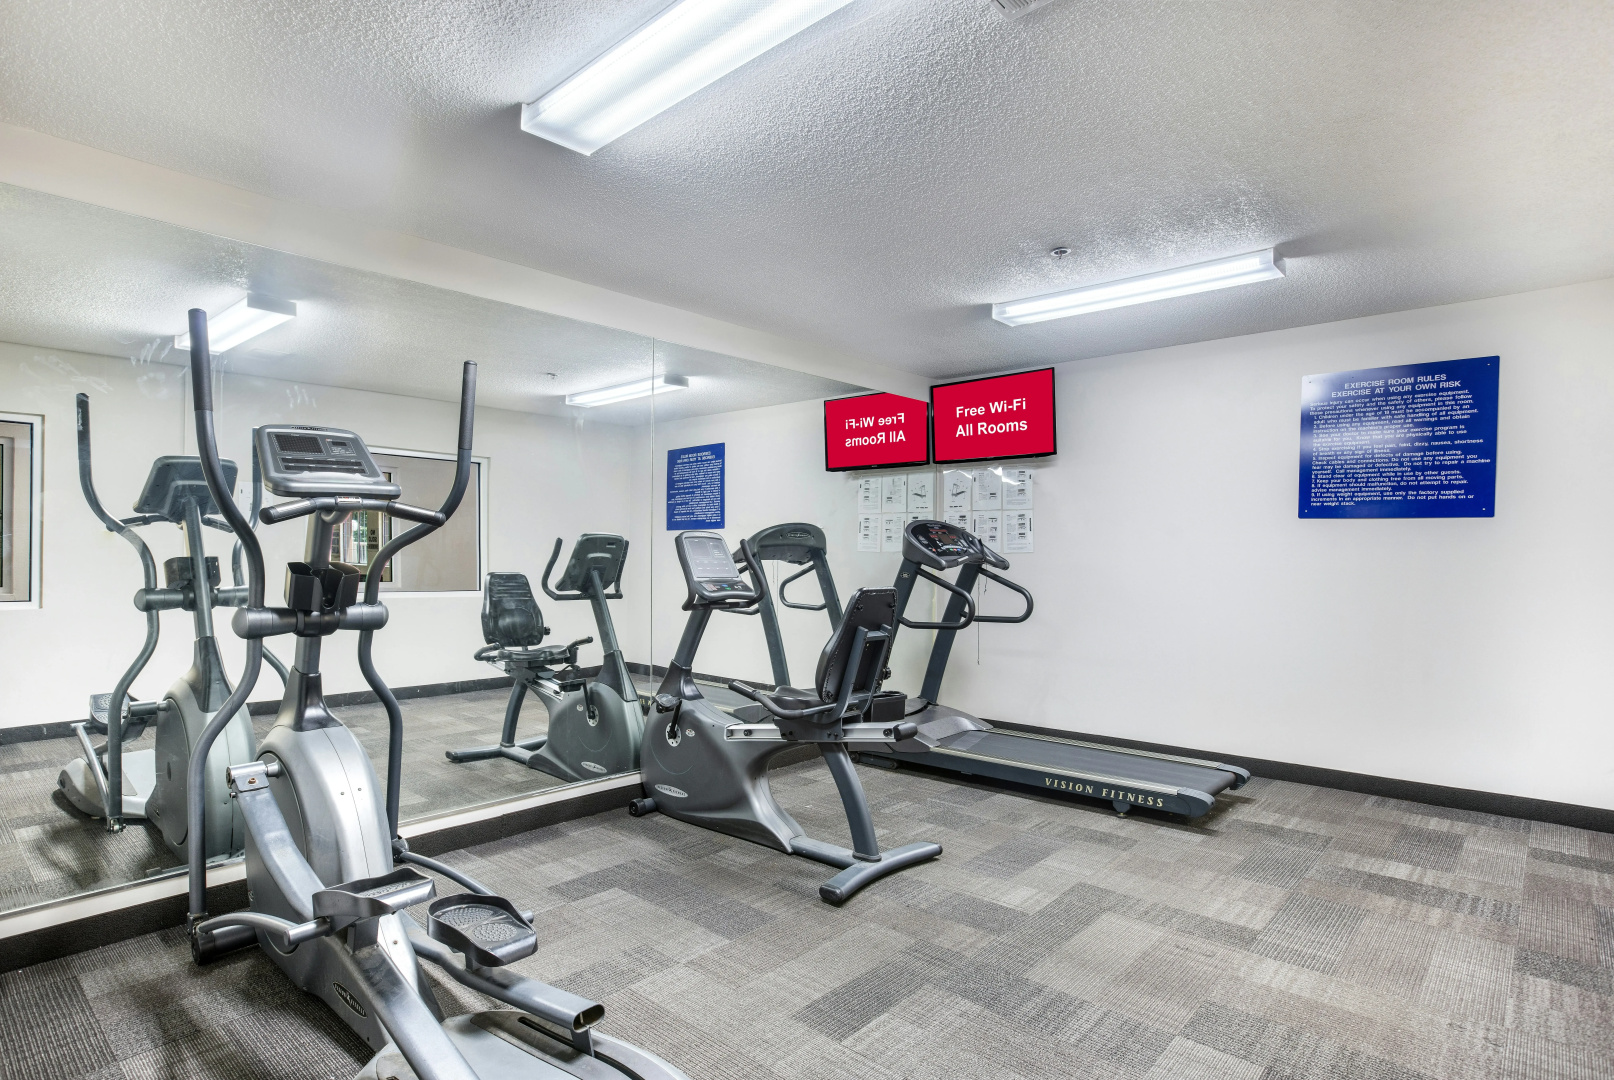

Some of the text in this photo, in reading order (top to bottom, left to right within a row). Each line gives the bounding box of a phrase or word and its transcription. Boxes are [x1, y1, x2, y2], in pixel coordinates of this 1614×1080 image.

[1332, 388, 1371, 398] EXERCISE
[1389, 385, 1412, 393] YOUR
[1415, 383, 1436, 391] OWN
[1440, 380, 1461, 389] RISK
[1344, 374, 1446, 389] EXERCISE ROOM RULES
[956, 398, 1026, 418] Free Wi-Fi
[956, 420, 1028, 438] All Rooms
[1045, 778, 1164, 807] VISION FITNESS
